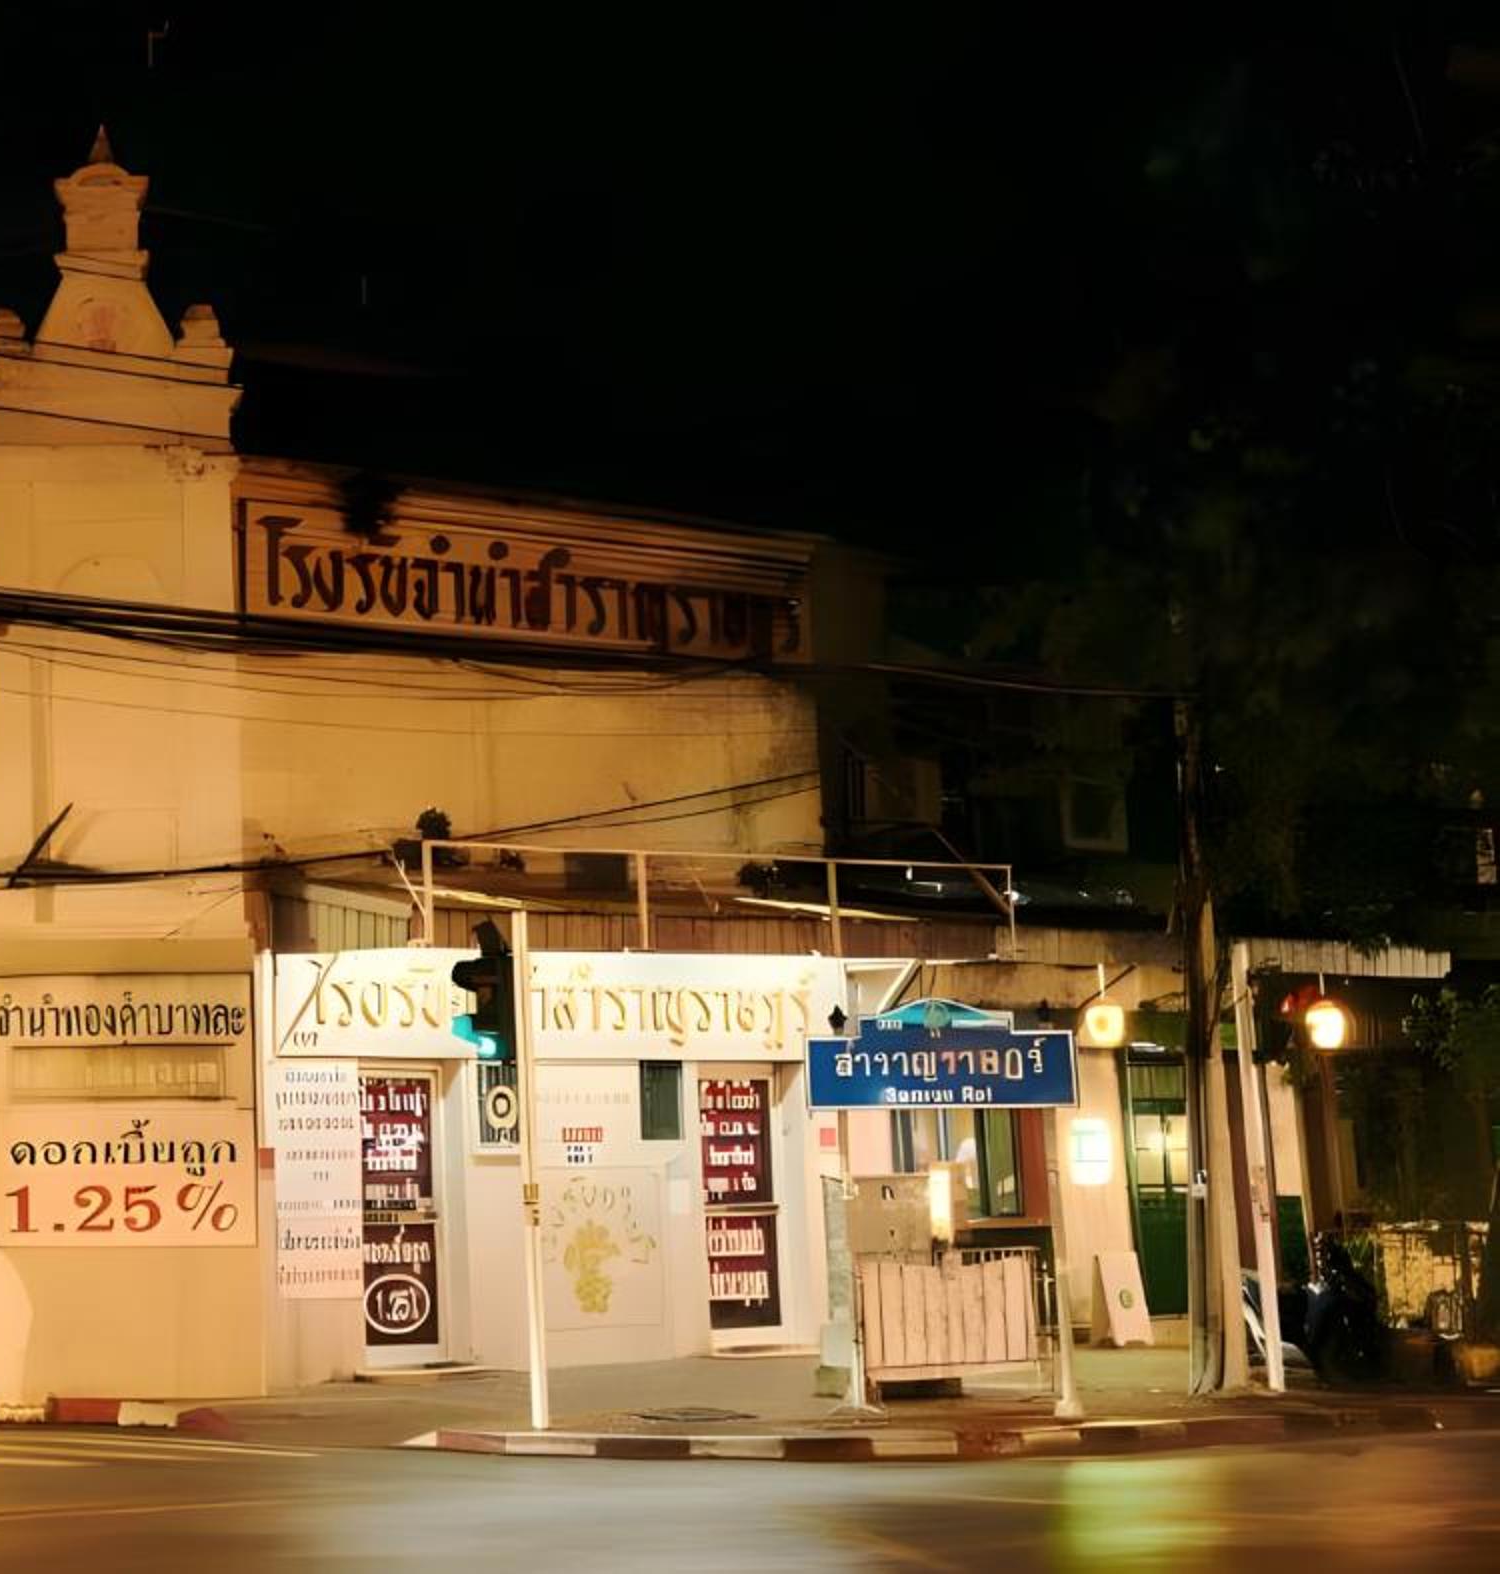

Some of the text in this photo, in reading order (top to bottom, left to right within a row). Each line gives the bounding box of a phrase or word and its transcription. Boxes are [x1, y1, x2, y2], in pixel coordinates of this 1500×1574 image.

[10, 1119, 237, 1177] ดอกเบี้ยถูก
